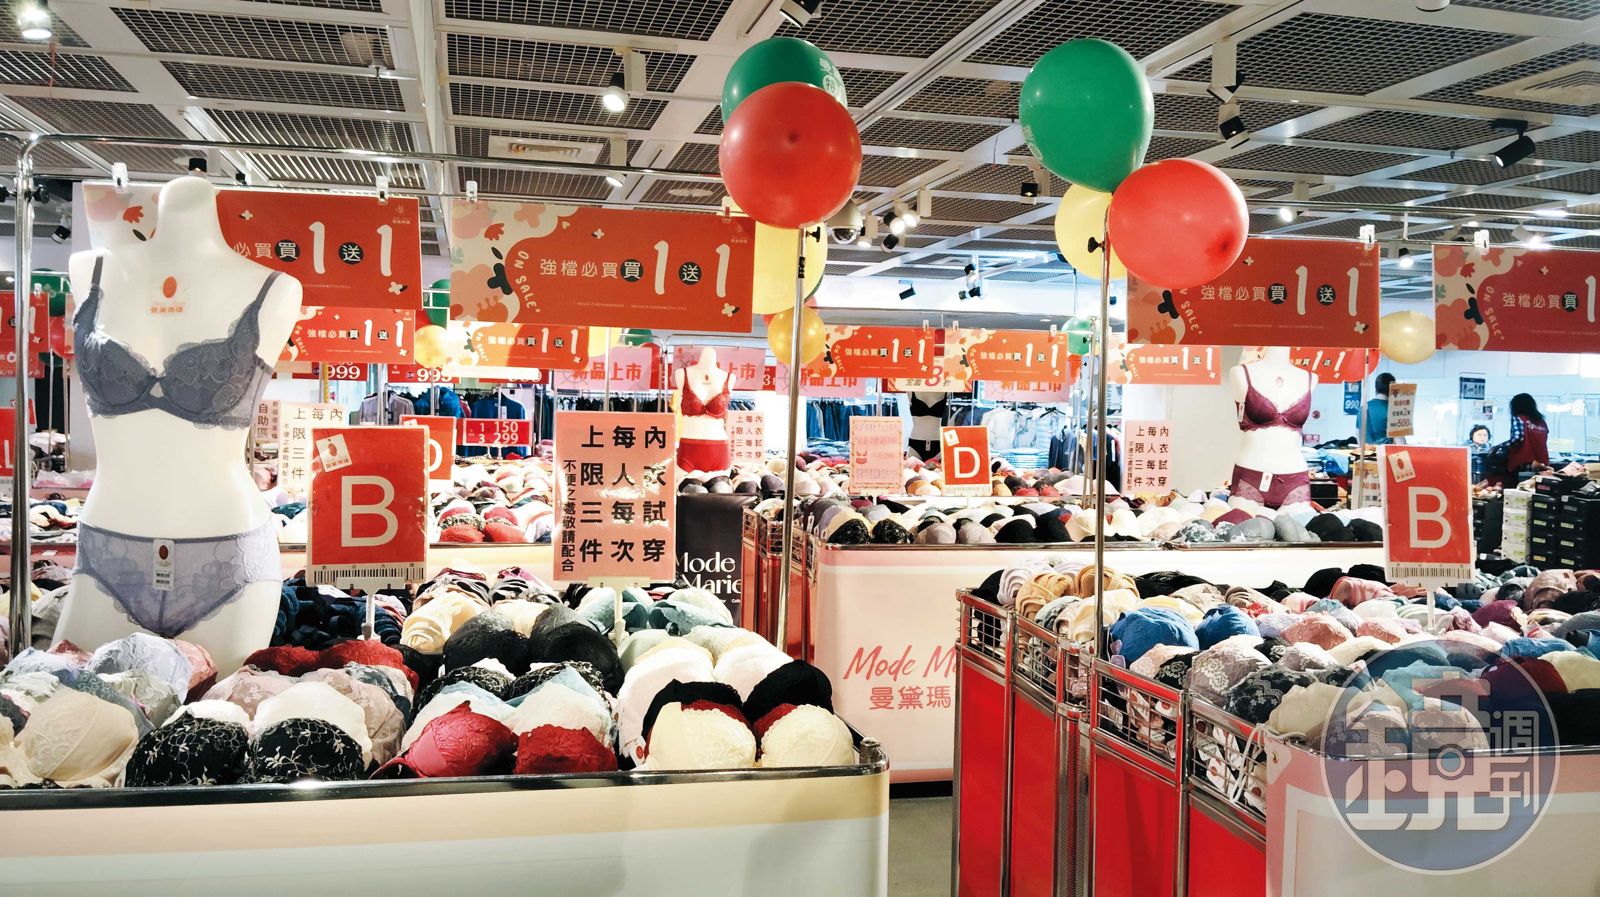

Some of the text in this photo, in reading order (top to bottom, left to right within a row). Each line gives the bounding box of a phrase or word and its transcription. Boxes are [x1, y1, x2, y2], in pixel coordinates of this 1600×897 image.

[516, 250, 537, 310] ON SALE
[1180, 300, 1199, 331] SALE
[1484, 307, 1502, 336] SALE
[493, 432, 519, 444] 299
[494, 421, 519, 433] 150
[953, 446, 981, 479] D
[341, 475, 399, 548] B
[1408, 486, 1452, 549] B
[676, 551, 736, 573] Mode
[681, 574, 742, 594] Marie
[843, 645, 916, 682] Mode
[869, 685, 952, 710] 曼黛瑪
